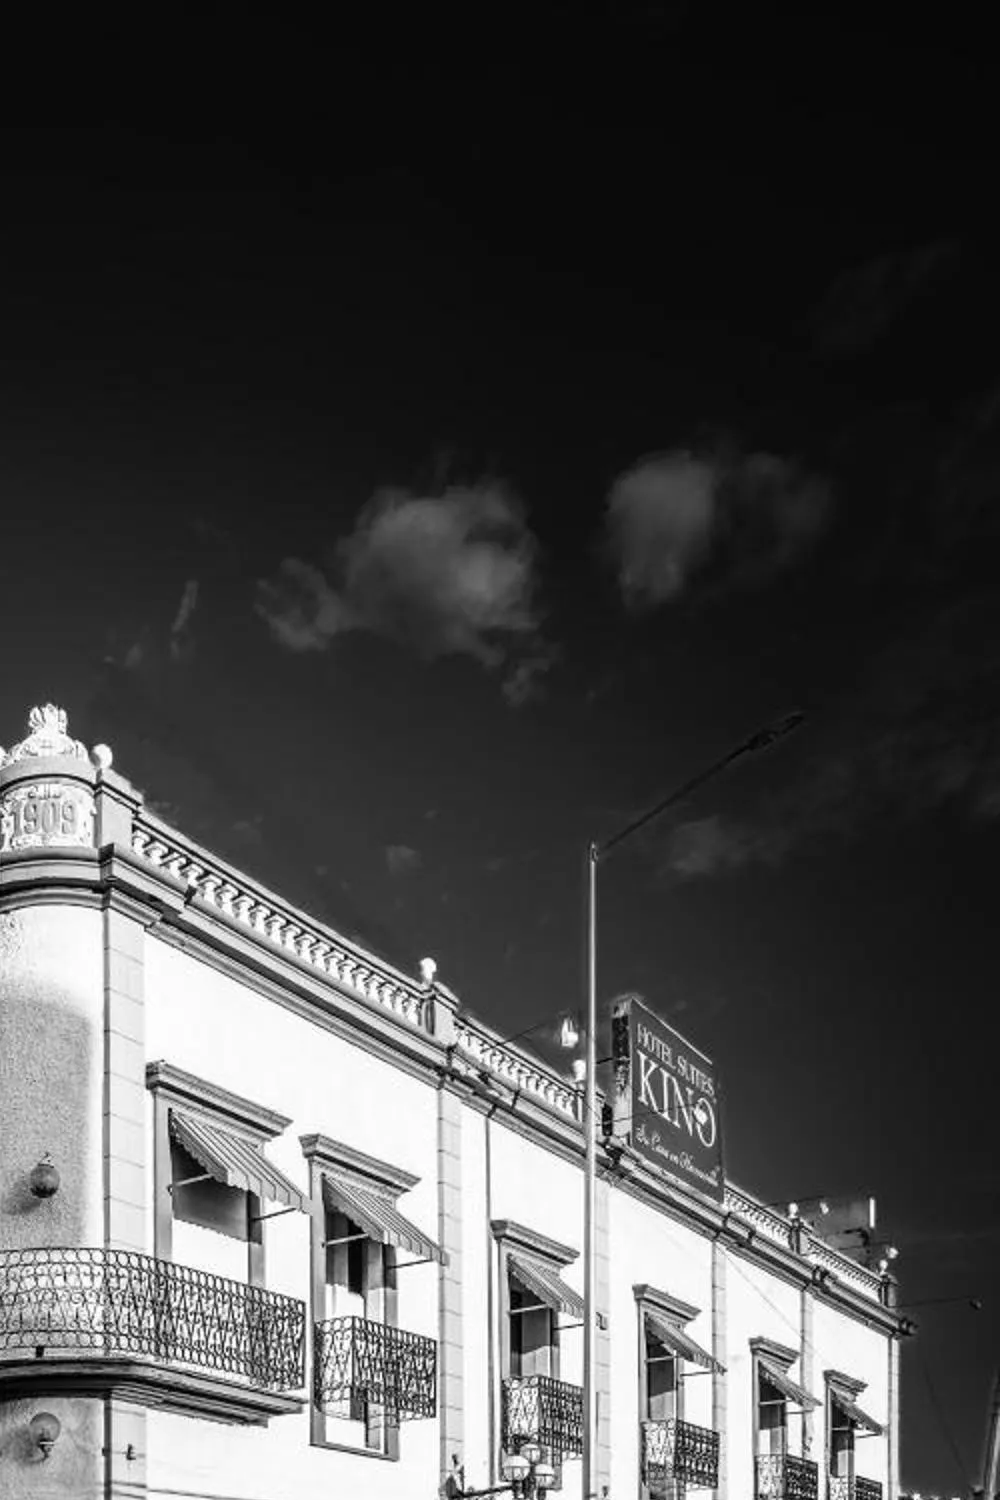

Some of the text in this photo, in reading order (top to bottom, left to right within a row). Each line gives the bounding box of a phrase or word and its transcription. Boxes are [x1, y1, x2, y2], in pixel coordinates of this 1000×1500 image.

[10, 799, 77, 836] 1909
[637, 1023, 715, 1097] HOTEL SUITES
[636, 1049, 716, 1147] KINO
